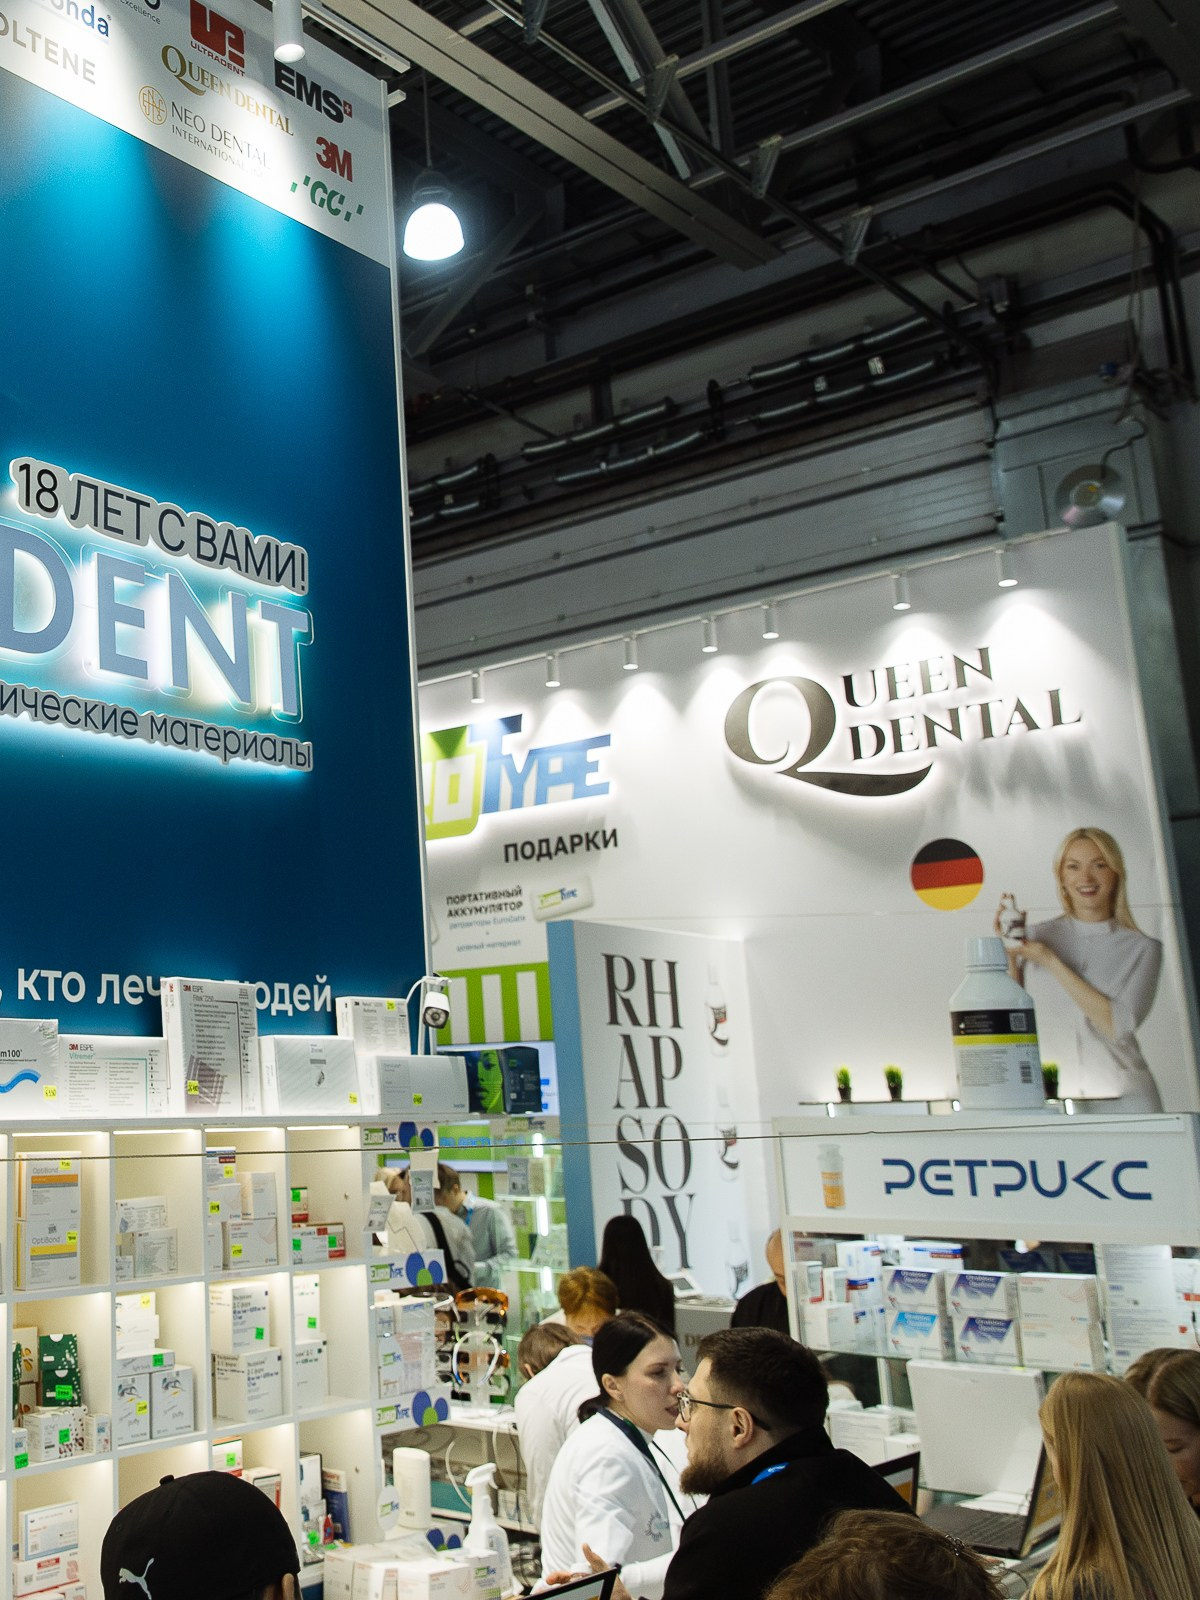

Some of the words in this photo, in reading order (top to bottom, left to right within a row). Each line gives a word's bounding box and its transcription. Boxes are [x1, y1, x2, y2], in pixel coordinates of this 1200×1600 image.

[190, 40, 246, 77] ULTRADENT
[161, 44, 232, 100] QUEEN
[235, 88, 294, 136] DENTAL
[274, 59, 344, 124] EMS
[171, 101, 206, 133] NEO
[211, 123, 271, 170] DENTAL
[315, 136, 353, 183] 3M
[18, 463, 59, 513] 18
[70, 479, 151, 541] ЛЕТ
[158, 508, 186, 552] С
[196, 518, 306, 591] ВАМИ!
[150, 715, 312, 770] материалы
[724, 645, 993, 798] QUEEN
[850, 688, 1082, 762] DENTAL
[503, 828, 618, 864] ПОДАРКИ
[446, 884, 523, 906] ПОРТАТИВНЫЙ
[447, 900, 524, 919] АККУМУЛЯТОР
[17, 968, 86, 1004] кто
[97, 973, 161, 1005] леч
[183, 984, 191, 992] 3M
[192, 985, 204, 993] ESPE
[69, 1043, 79, 1051] 3M
[69, 1051, 94, 1060] Vitremer
